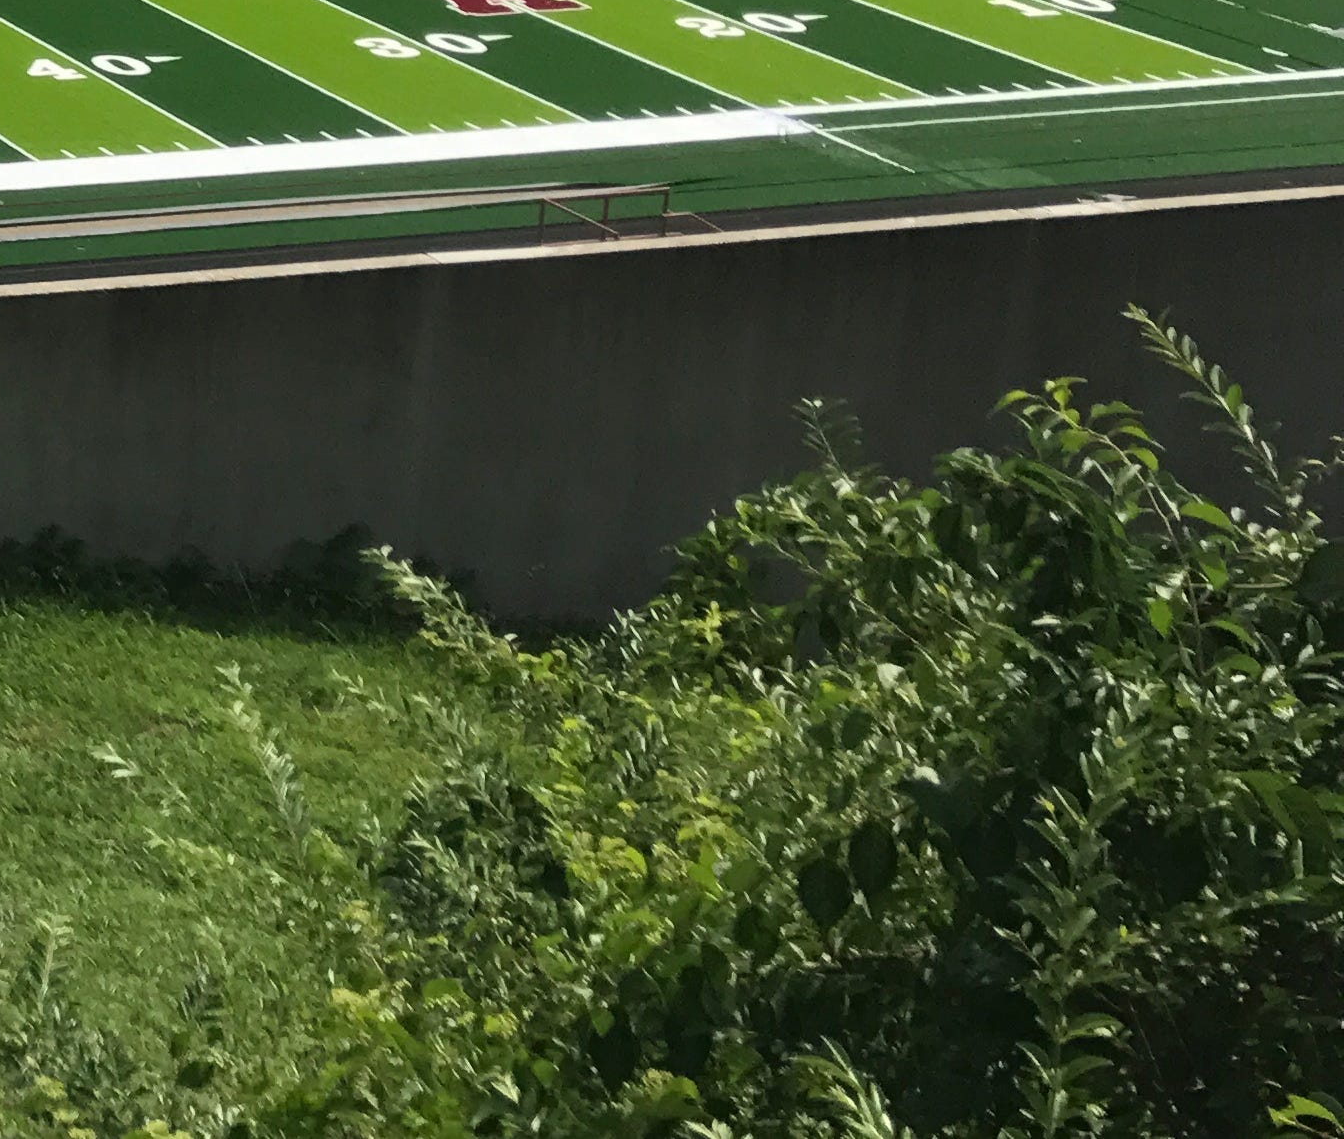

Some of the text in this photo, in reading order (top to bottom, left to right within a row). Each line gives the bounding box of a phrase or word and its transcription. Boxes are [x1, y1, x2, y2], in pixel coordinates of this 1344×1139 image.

[675, 12, 808, 38] 20
[354, 32, 488, 59] 30
[27, 54, 152, 80] 40
